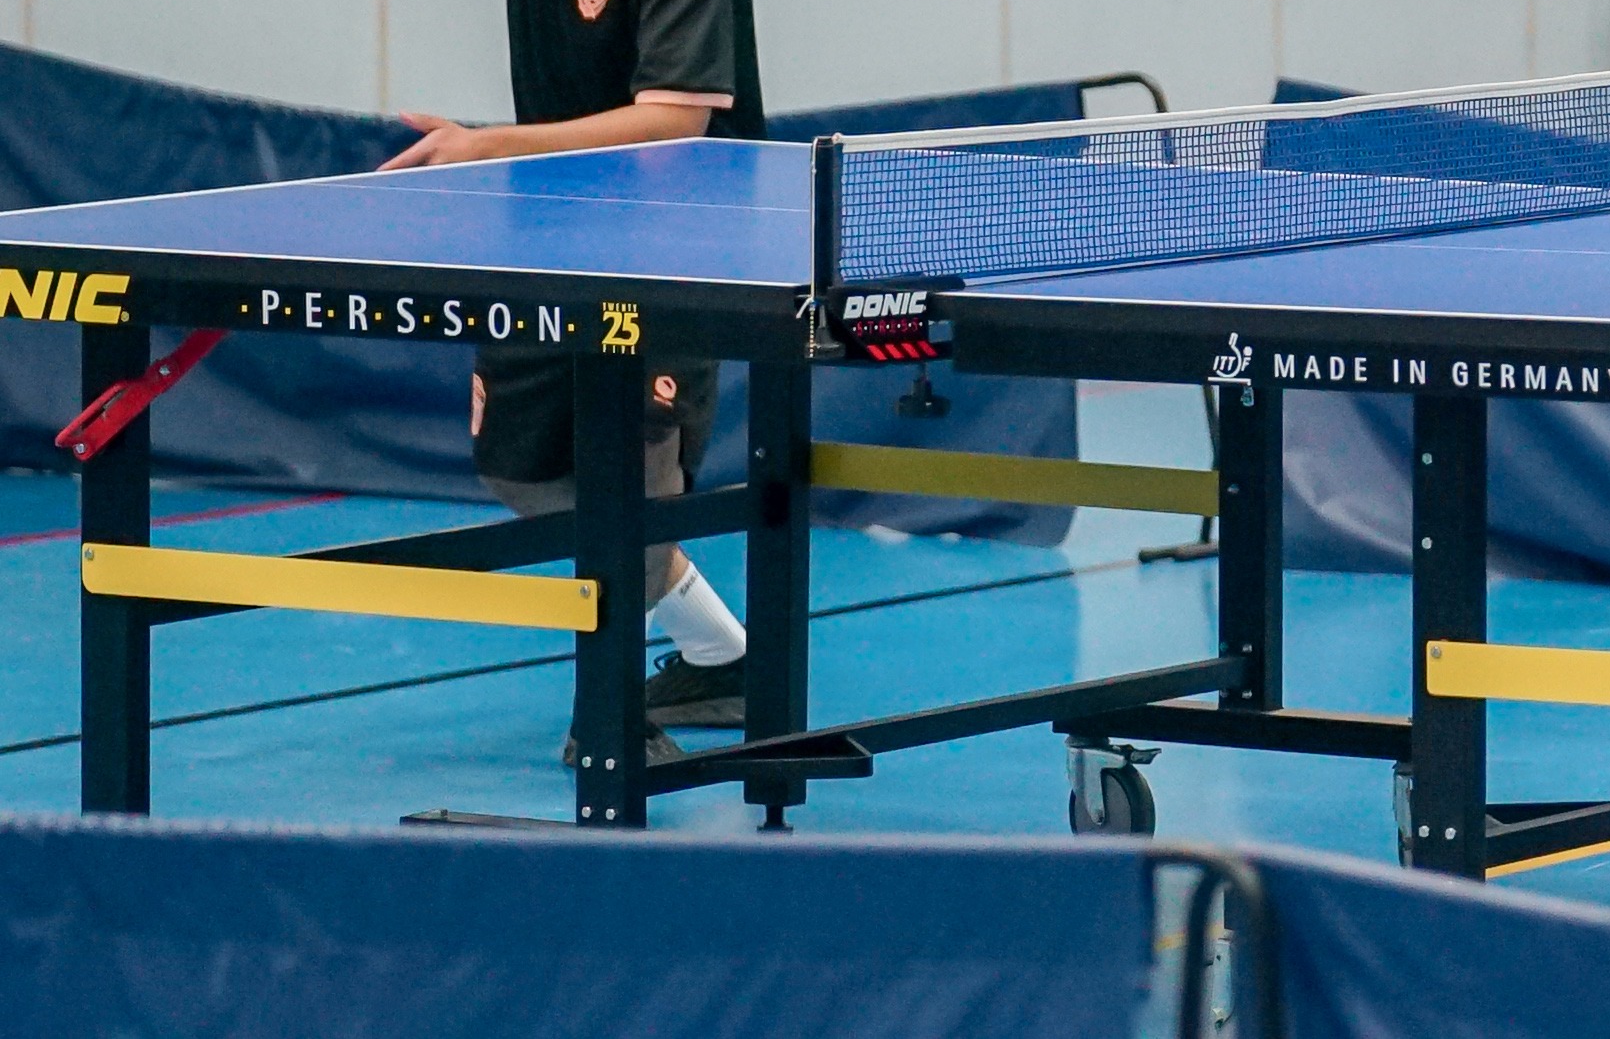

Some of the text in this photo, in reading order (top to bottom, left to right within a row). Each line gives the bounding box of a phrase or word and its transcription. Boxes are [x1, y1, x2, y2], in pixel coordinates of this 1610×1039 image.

[843, 291, 927, 320] DONIC
[601, 311, 641, 345] 25
[1274, 353, 1368, 382] MADE
[1393, 358, 1426, 385] IN
